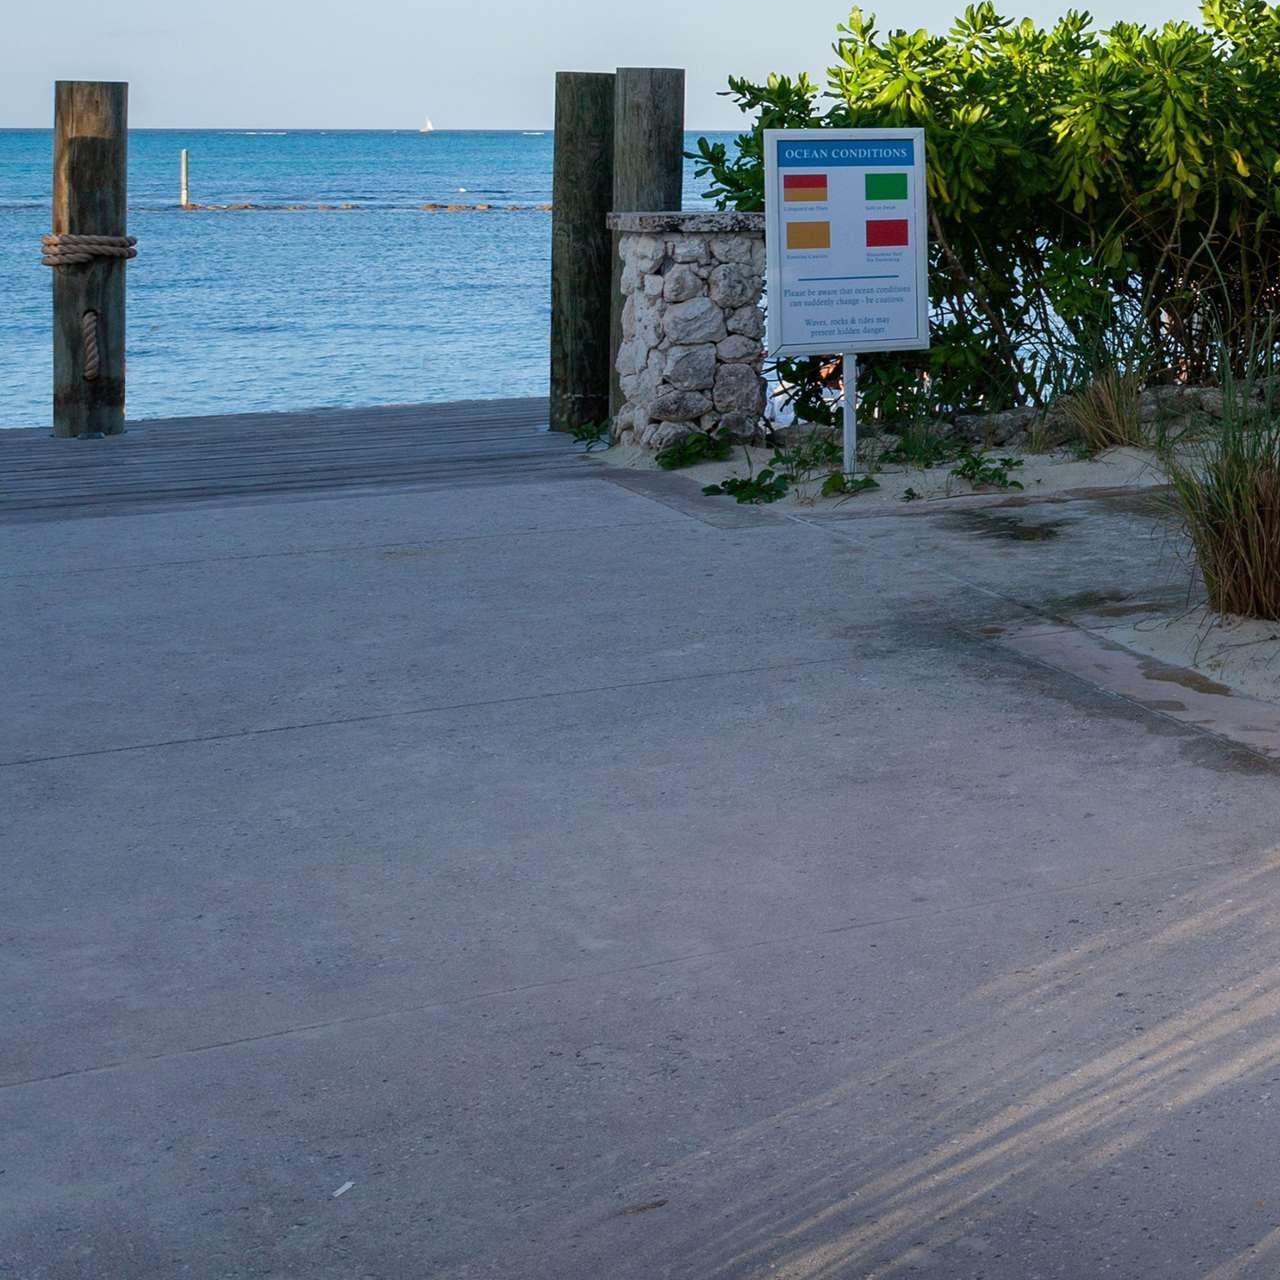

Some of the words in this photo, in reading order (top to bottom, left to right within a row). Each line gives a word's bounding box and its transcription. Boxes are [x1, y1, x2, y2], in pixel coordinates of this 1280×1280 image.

[785, 148, 828, 159] OCEAN
[831, 148, 908, 158] CONDITIONS
[783, 289, 806, 298] Please
[807, 288, 816, 296] be
[876, 285, 911, 294] conditions
[804, 298, 834, 308] suddenly
